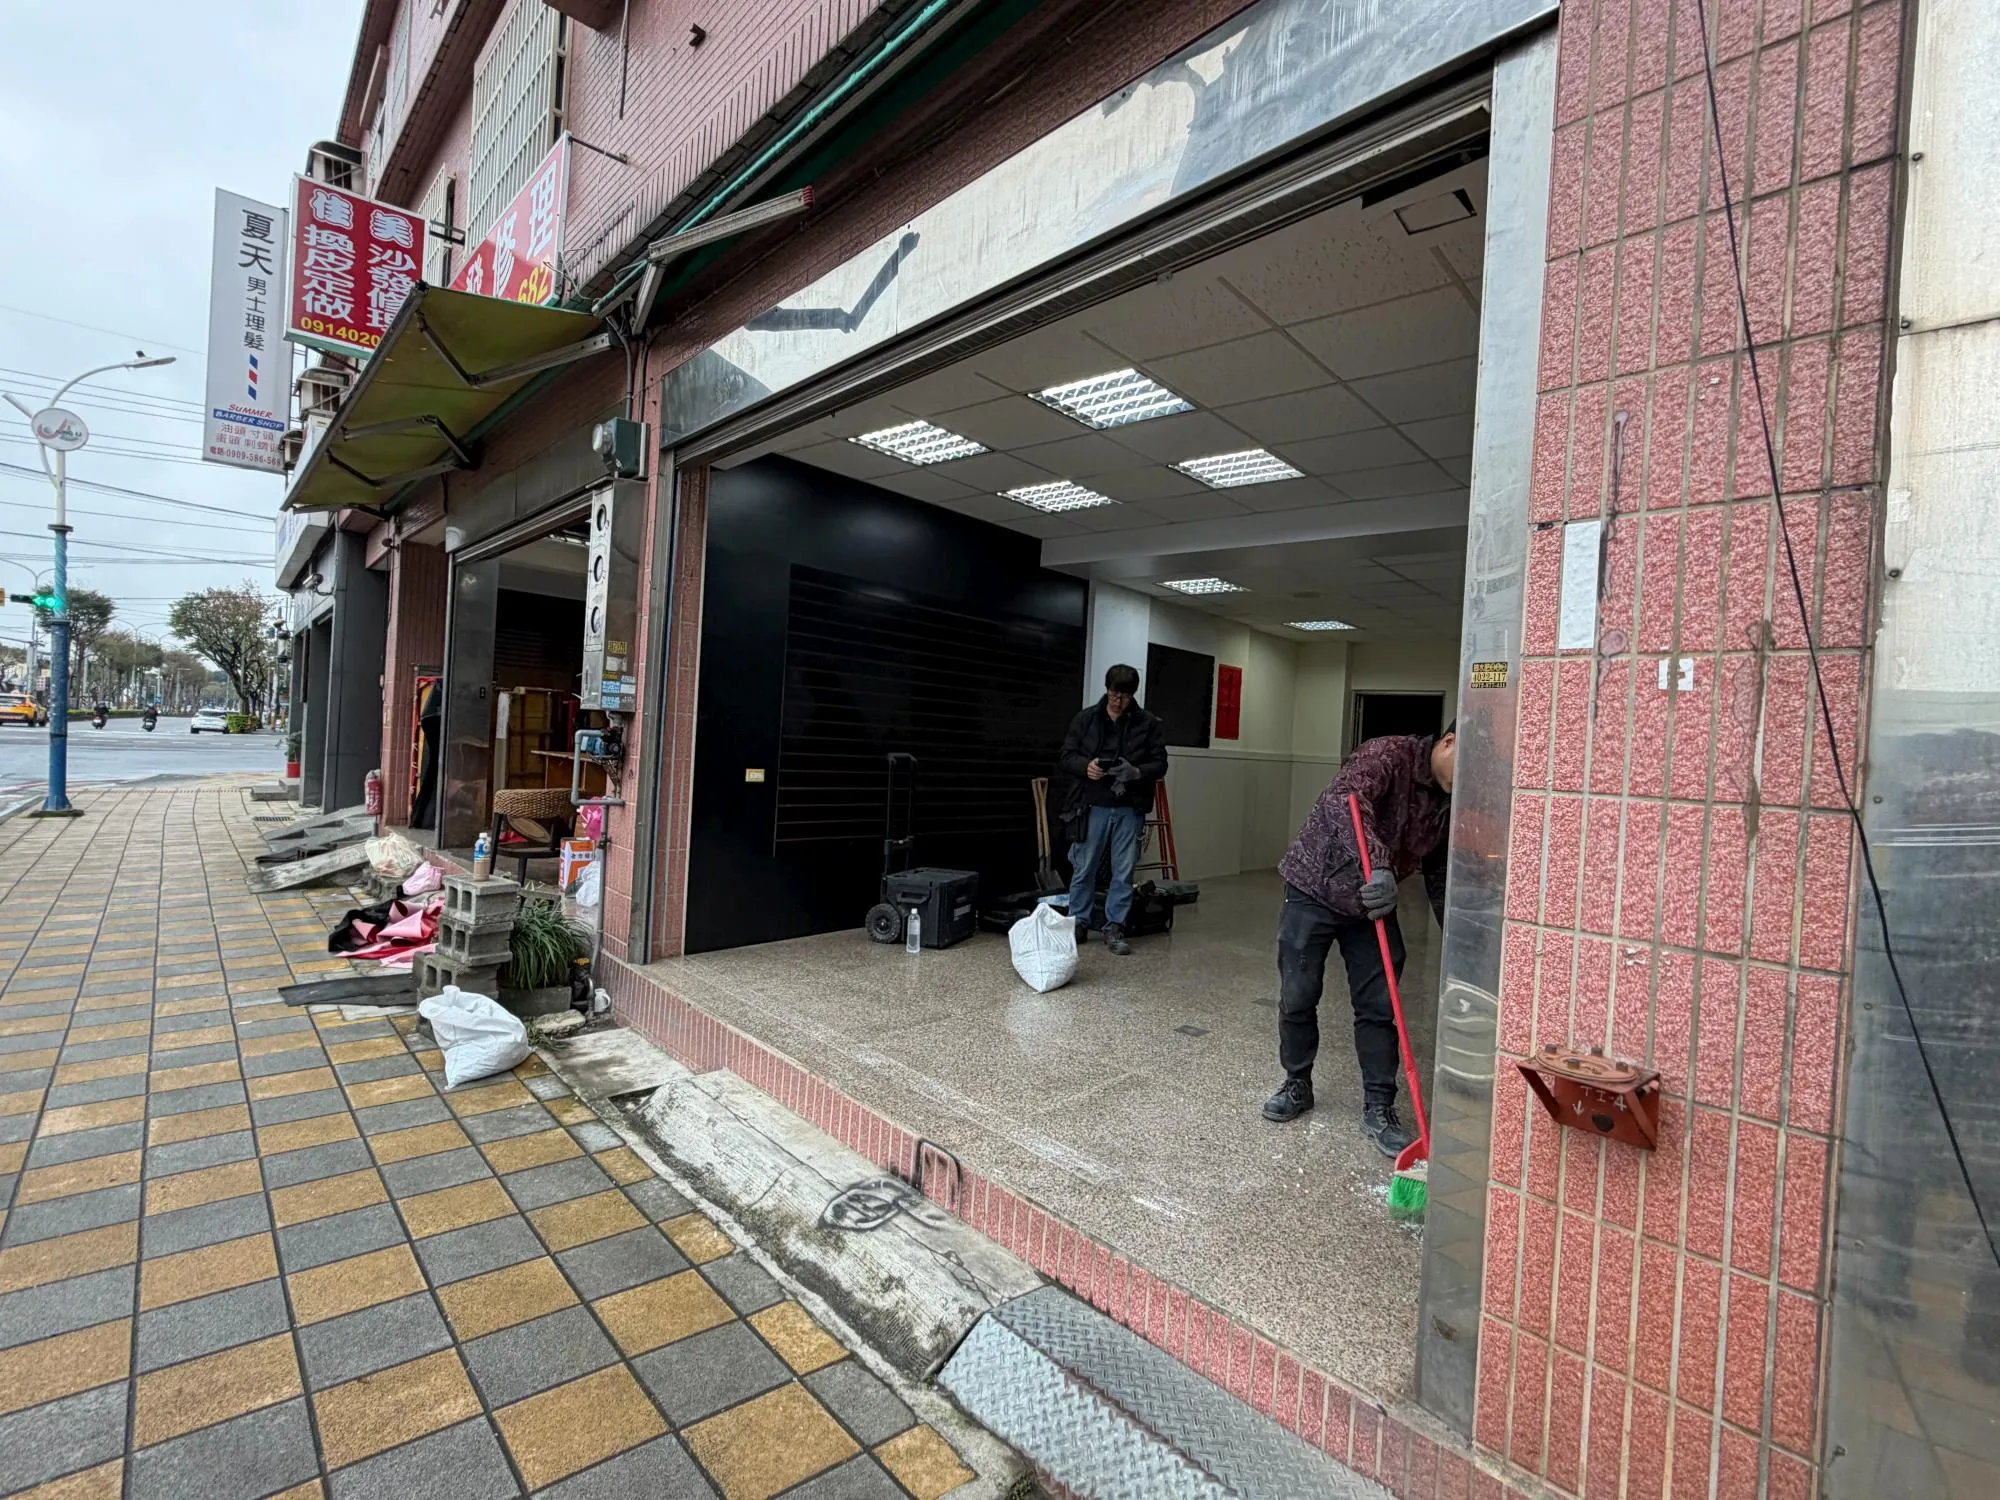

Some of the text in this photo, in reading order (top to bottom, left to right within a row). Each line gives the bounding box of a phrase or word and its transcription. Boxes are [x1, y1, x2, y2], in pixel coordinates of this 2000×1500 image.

[238, 208, 275, 276] 夏天
[214, 410, 284, 430] BARBER SHOP
[229, 404, 273, 418] SUMMER
